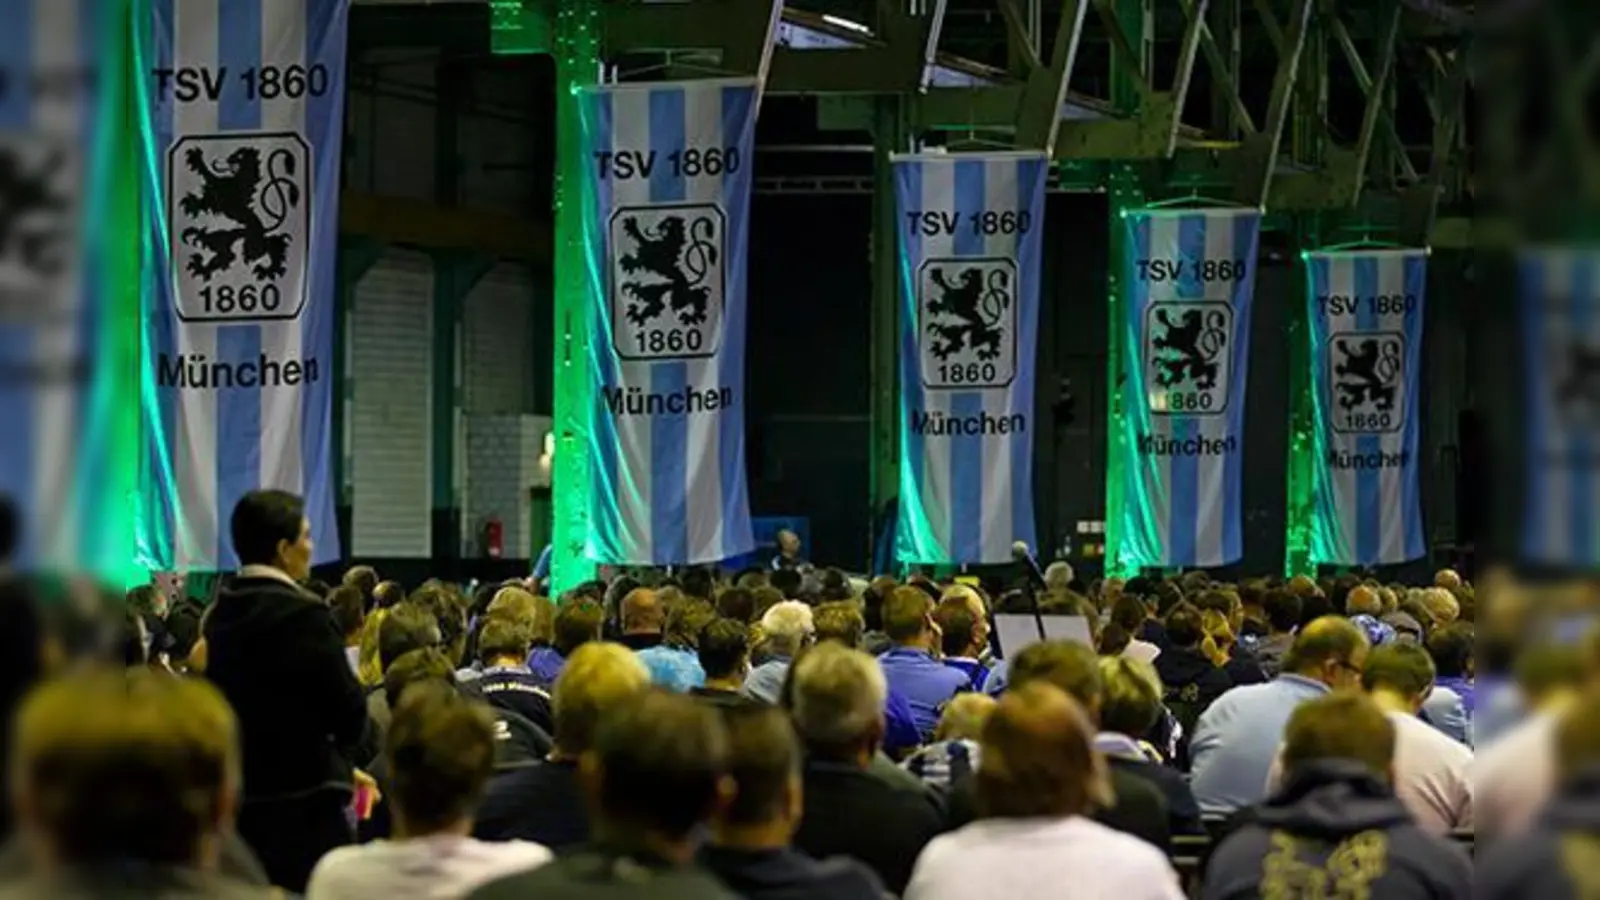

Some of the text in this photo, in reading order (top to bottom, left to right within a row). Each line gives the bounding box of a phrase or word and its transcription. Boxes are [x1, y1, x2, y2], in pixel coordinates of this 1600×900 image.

[152, 64, 328, 101] TSV 1860
[594, 147, 740, 180] TSV 1860
[906, 211, 1031, 236] TSV 1860
[1136, 260, 1247, 282] TSV 1860
[199, 284, 280, 313] 1860
[1317, 294, 1417, 316] TSV 1860
[635, 329, 702, 353] 1860
[157, 353, 318, 388] München
[937, 363, 996, 383] 1860
[602, 384, 733, 416] München
[910, 410, 1026, 436] München
[1345, 412, 1391, 428] 1860
